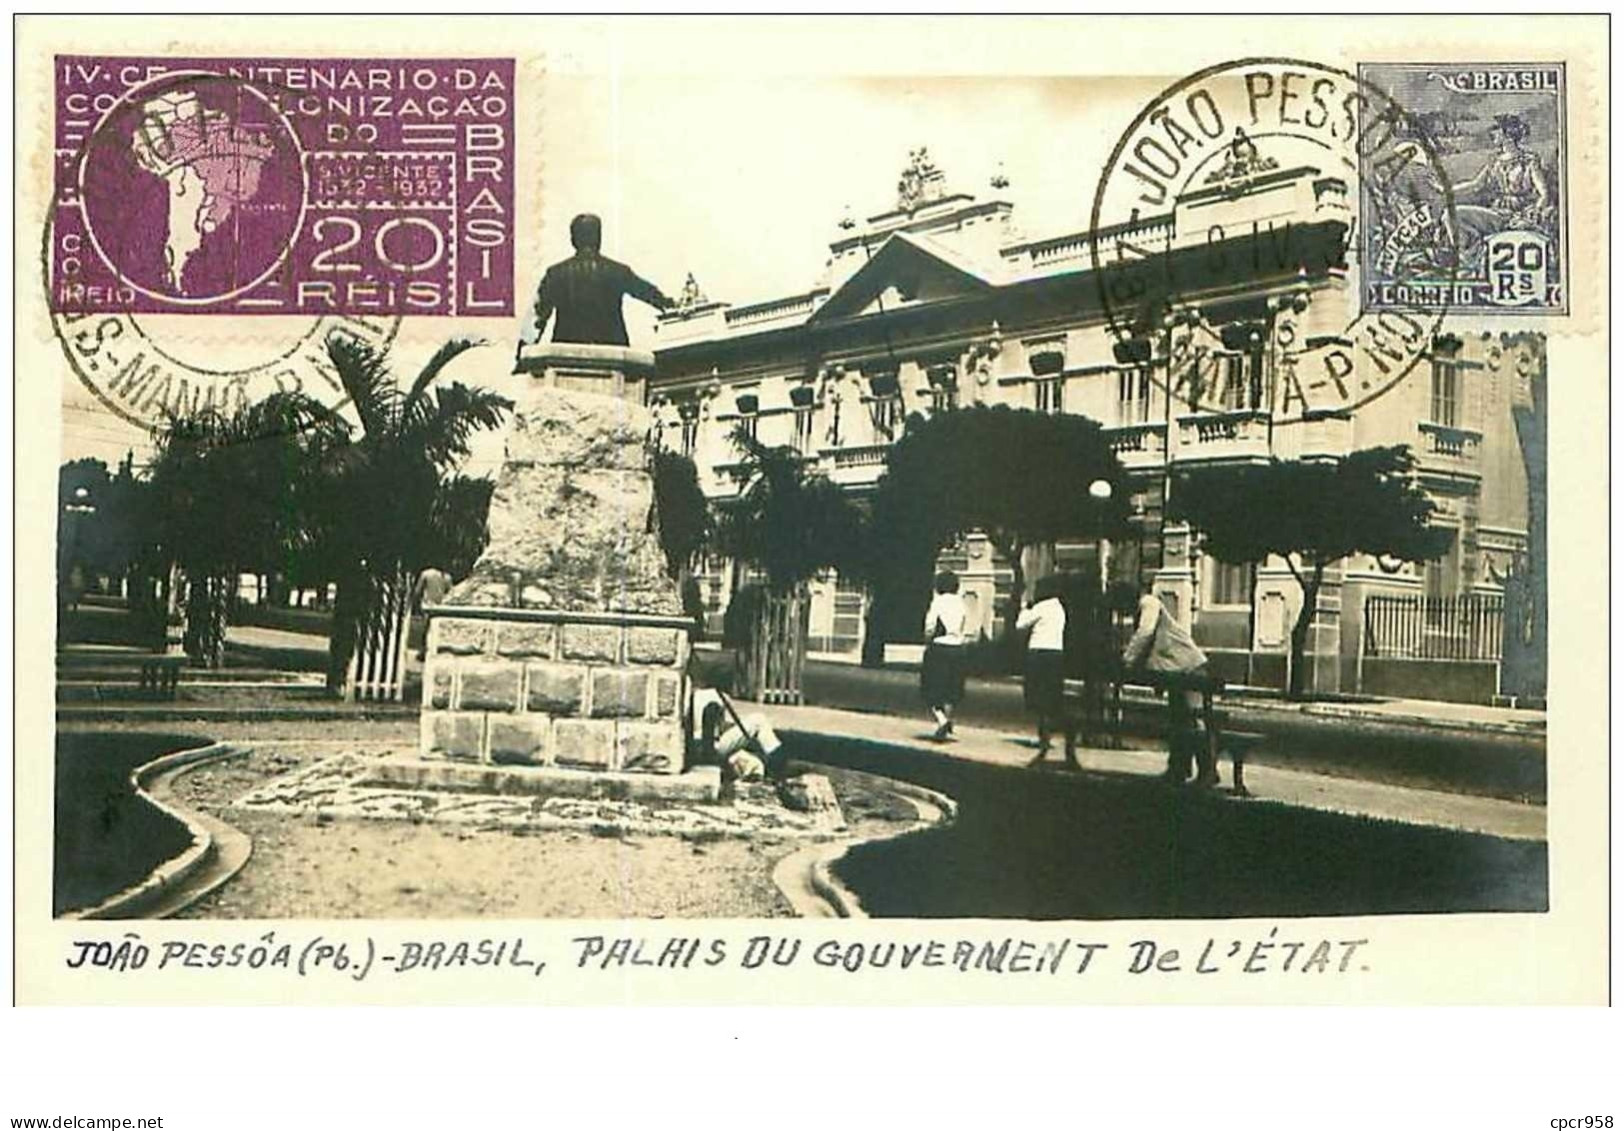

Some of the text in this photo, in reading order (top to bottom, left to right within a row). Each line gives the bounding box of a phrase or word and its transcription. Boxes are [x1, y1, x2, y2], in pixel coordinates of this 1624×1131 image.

[1473, 72, 1557, 91] BRASIL
[326, 123, 379, 144] DO
[464, 123, 506, 308] BRASIL
[311, 215, 445, 272] 20
[1491, 241, 1543, 272] 20
[297, 275, 442, 307] RÉIS
[1382, 285, 1474, 306] CORREIO
[66, 932, 150, 972] JOÃO
[158, 931, 291, 970] PESSÔA
[740, 936, 801, 969] DU
